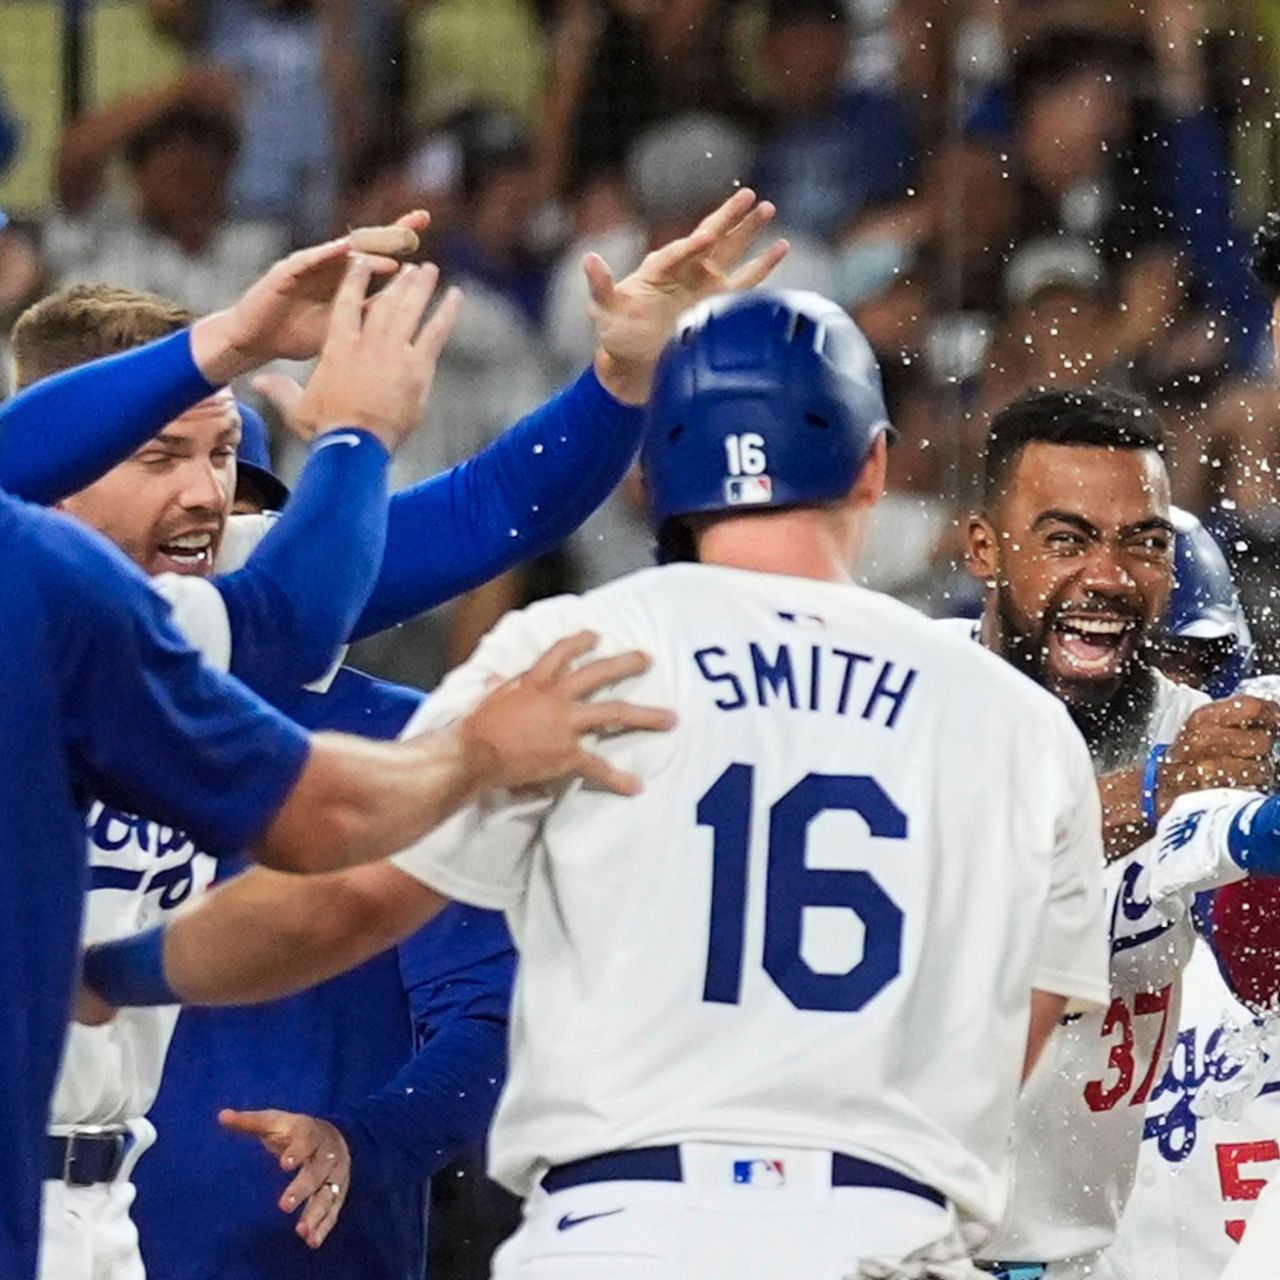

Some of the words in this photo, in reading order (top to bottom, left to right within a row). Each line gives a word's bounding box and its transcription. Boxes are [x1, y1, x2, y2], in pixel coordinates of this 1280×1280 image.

[724, 432, 767, 476] 16
[693, 642, 919, 729] SMITH
[695, 761, 909, 1013] 16
[1083, 983, 1174, 1112] 37
